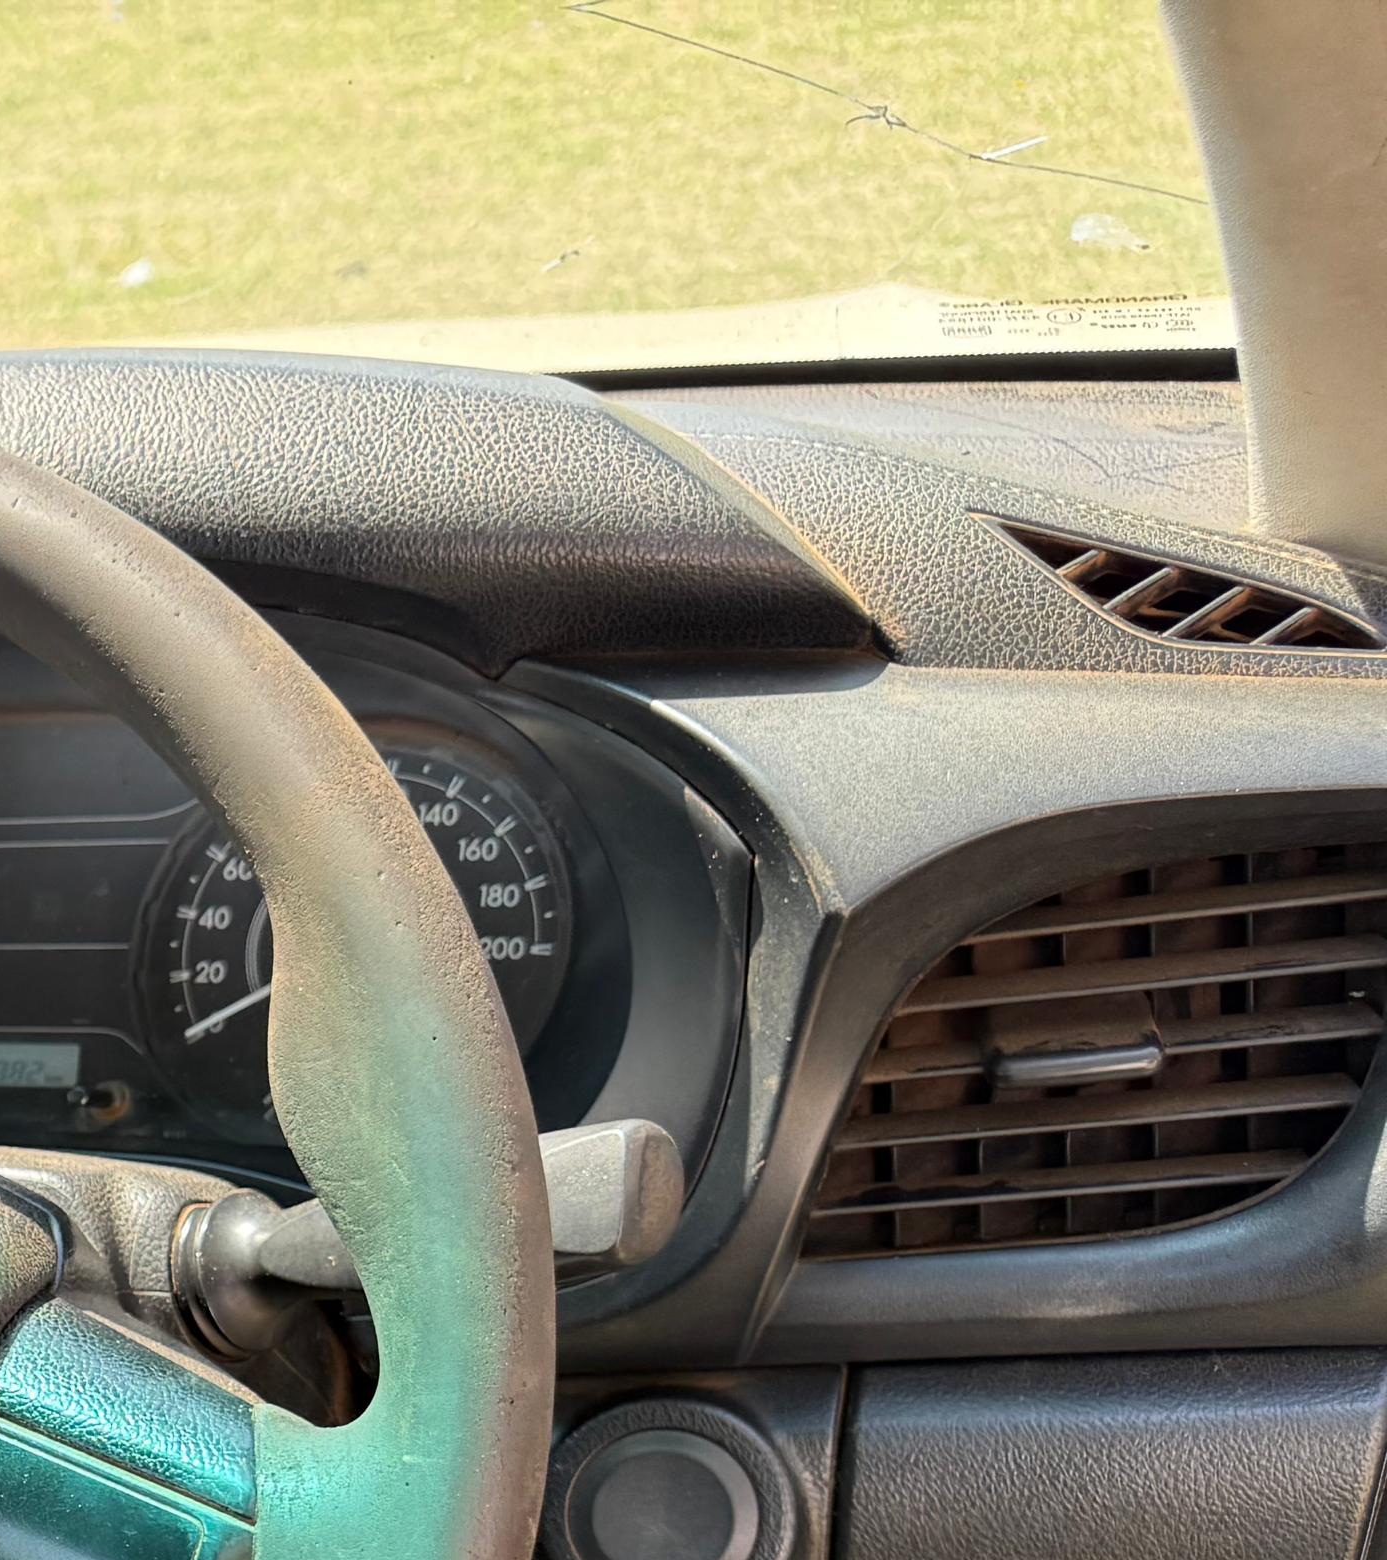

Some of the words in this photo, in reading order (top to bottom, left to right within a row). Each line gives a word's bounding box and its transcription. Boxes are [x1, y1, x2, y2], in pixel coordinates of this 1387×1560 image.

[418, 802, 459, 826] 140
[458, 837, 499, 862] 160
[223, 857, 253, 881] 60
[479, 884, 520, 908] 180
[198, 906, 232, 929] 40
[480, 936, 525, 960] 200
[195, 961, 225, 984] 20
